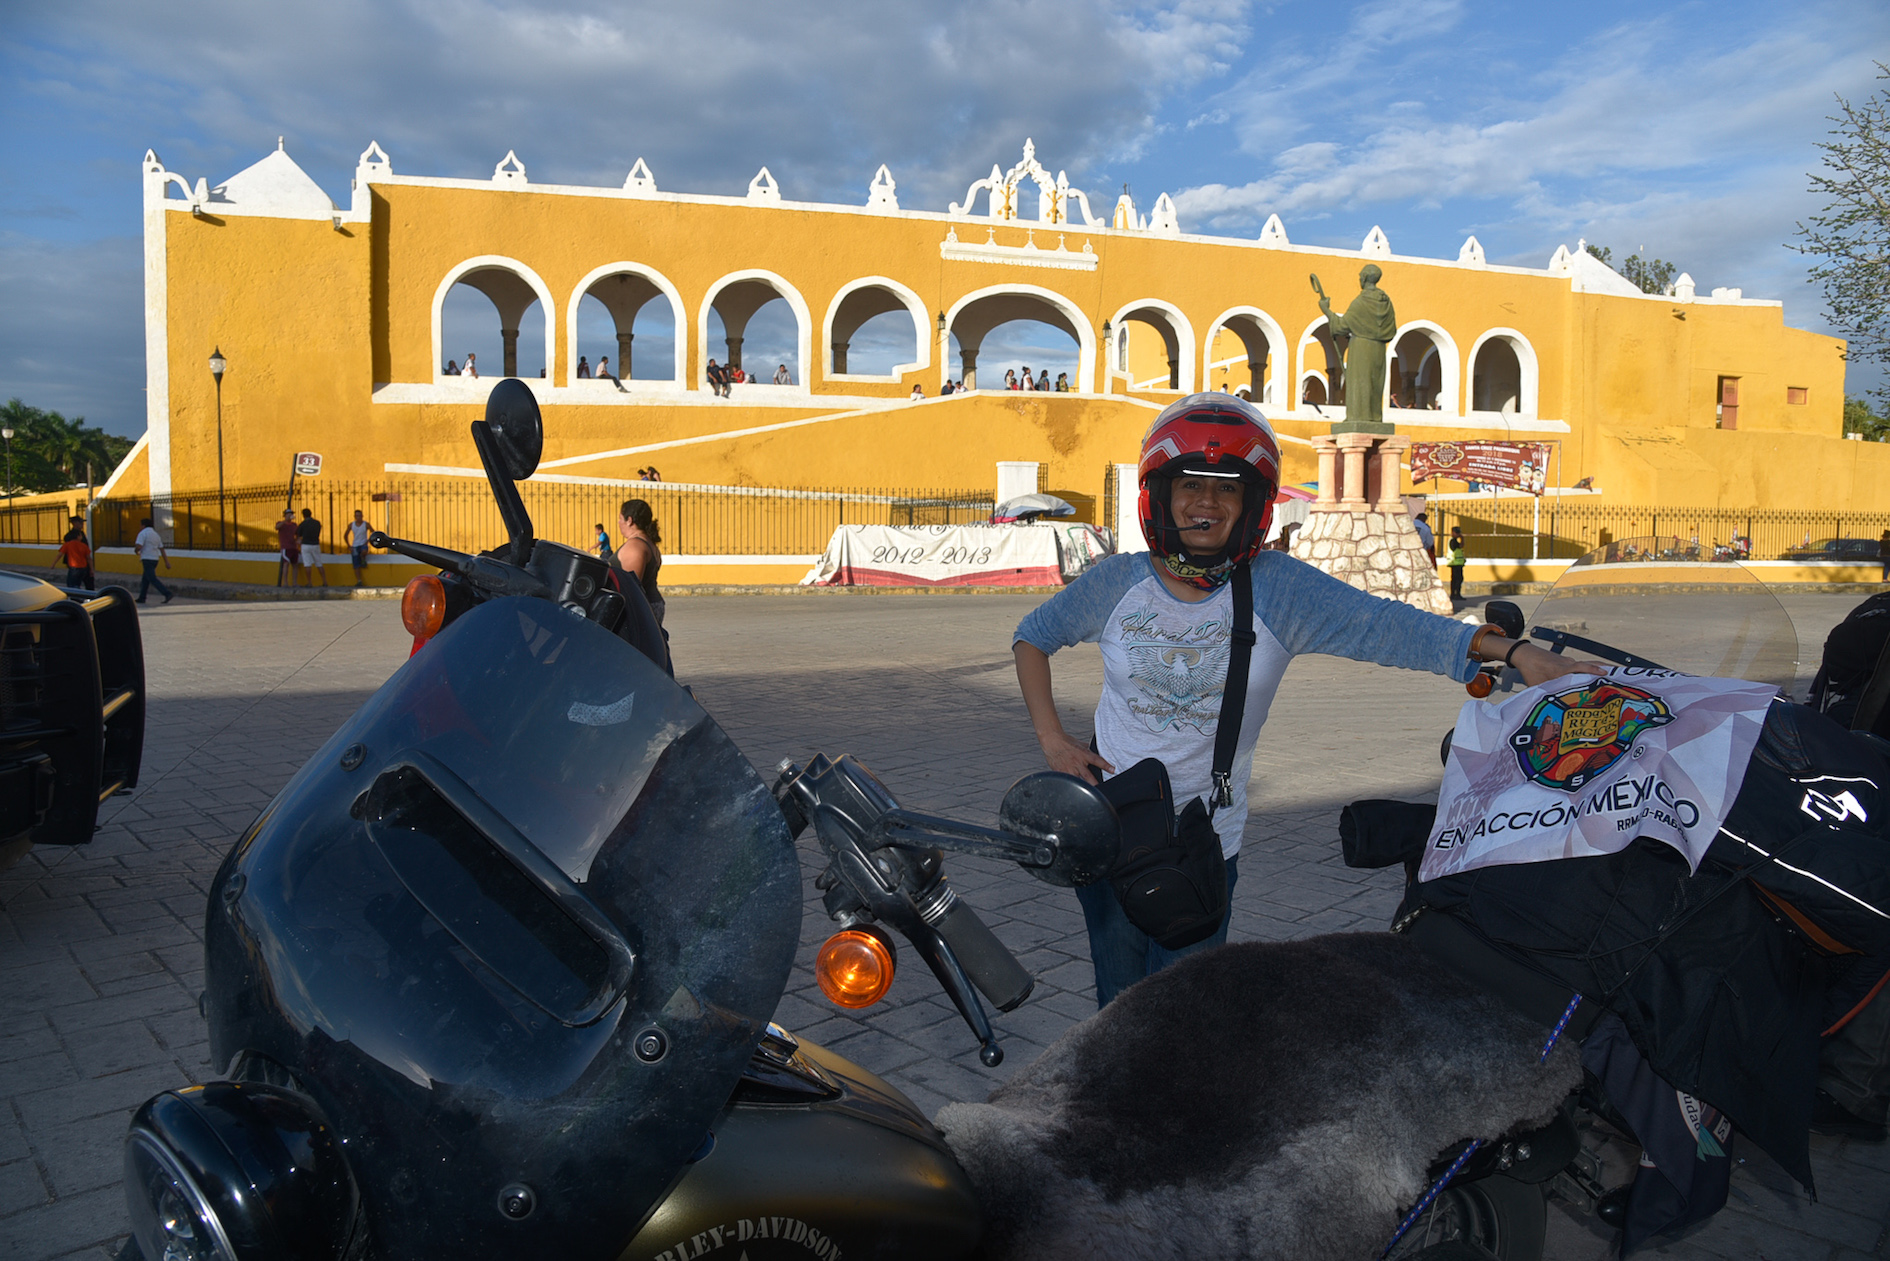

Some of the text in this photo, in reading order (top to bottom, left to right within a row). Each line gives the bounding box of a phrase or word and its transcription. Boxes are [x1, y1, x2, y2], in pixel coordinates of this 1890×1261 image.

[303, 457, 315, 466] 33
[1119, 612, 1193, 643] Hard
[1434, 774, 1700, 849] EN ACCIÓN MÉXICO
